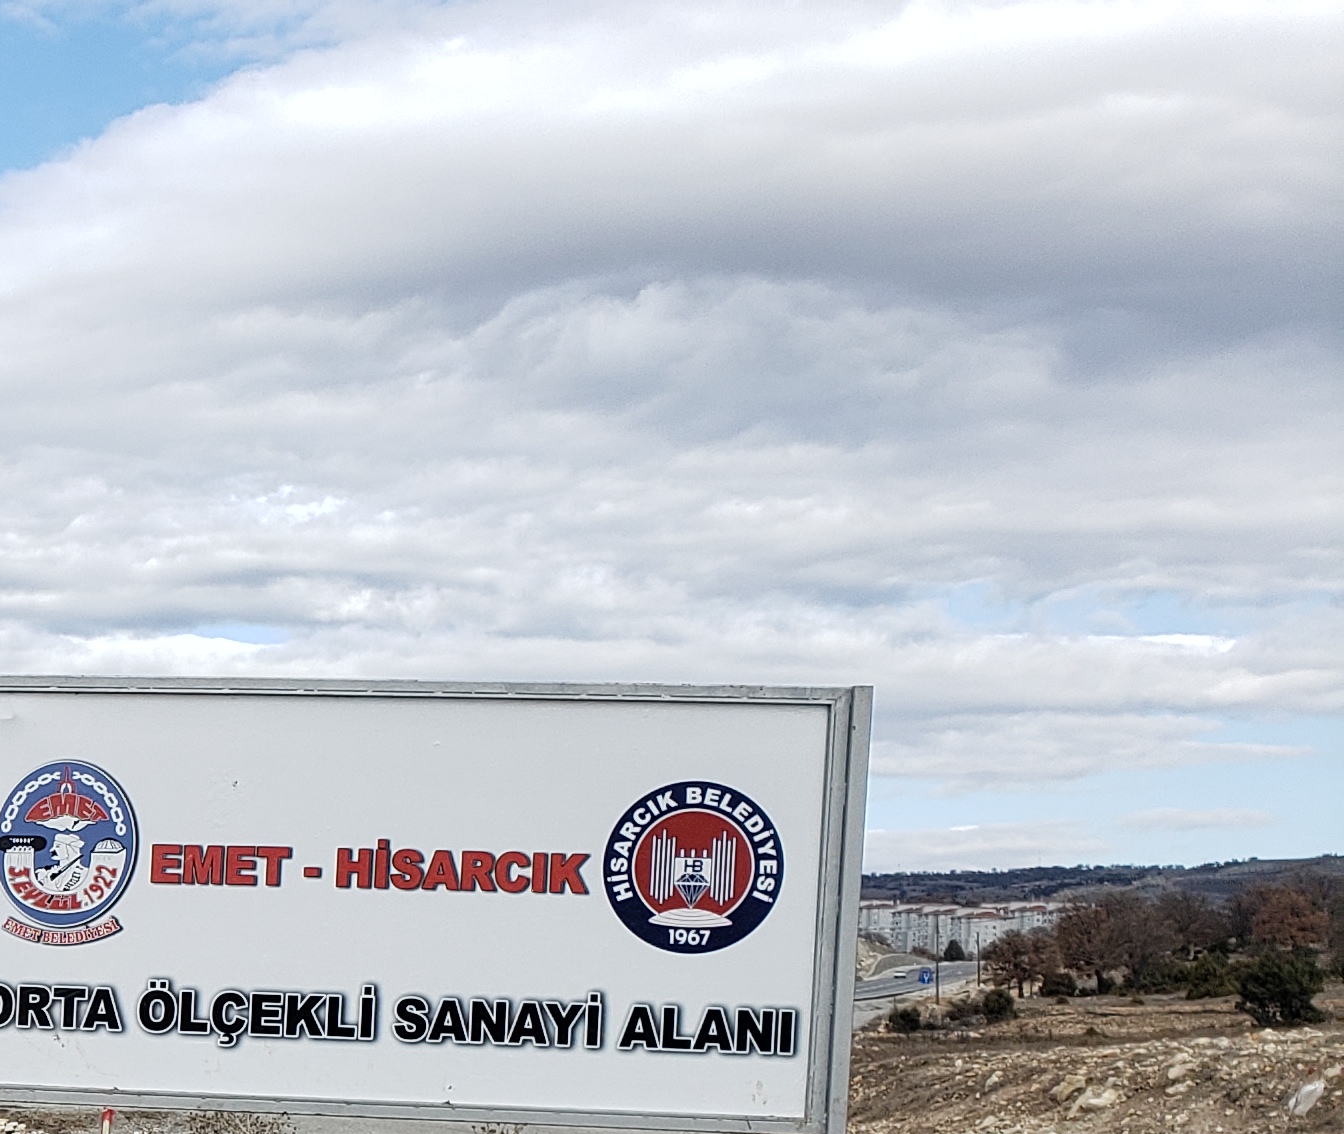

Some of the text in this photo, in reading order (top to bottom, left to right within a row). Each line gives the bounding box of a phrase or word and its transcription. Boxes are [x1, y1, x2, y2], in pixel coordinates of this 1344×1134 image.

[24, 793, 110, 822] EMET
[607, 786, 778, 904] HİSARCIK BELEDİYESİ
[150, 843, 292, 887] EMET
[335, 838, 590, 896] HİSARCIK
[3, 918, 41, 941] EMET
[668, 928, 711, 946] 1967
[137, 978, 376, 1047] ÖLÇEKLİ
[393, 992, 602, 1049] SANAYİ
[617, 1003, 796, 1056] ALANI
